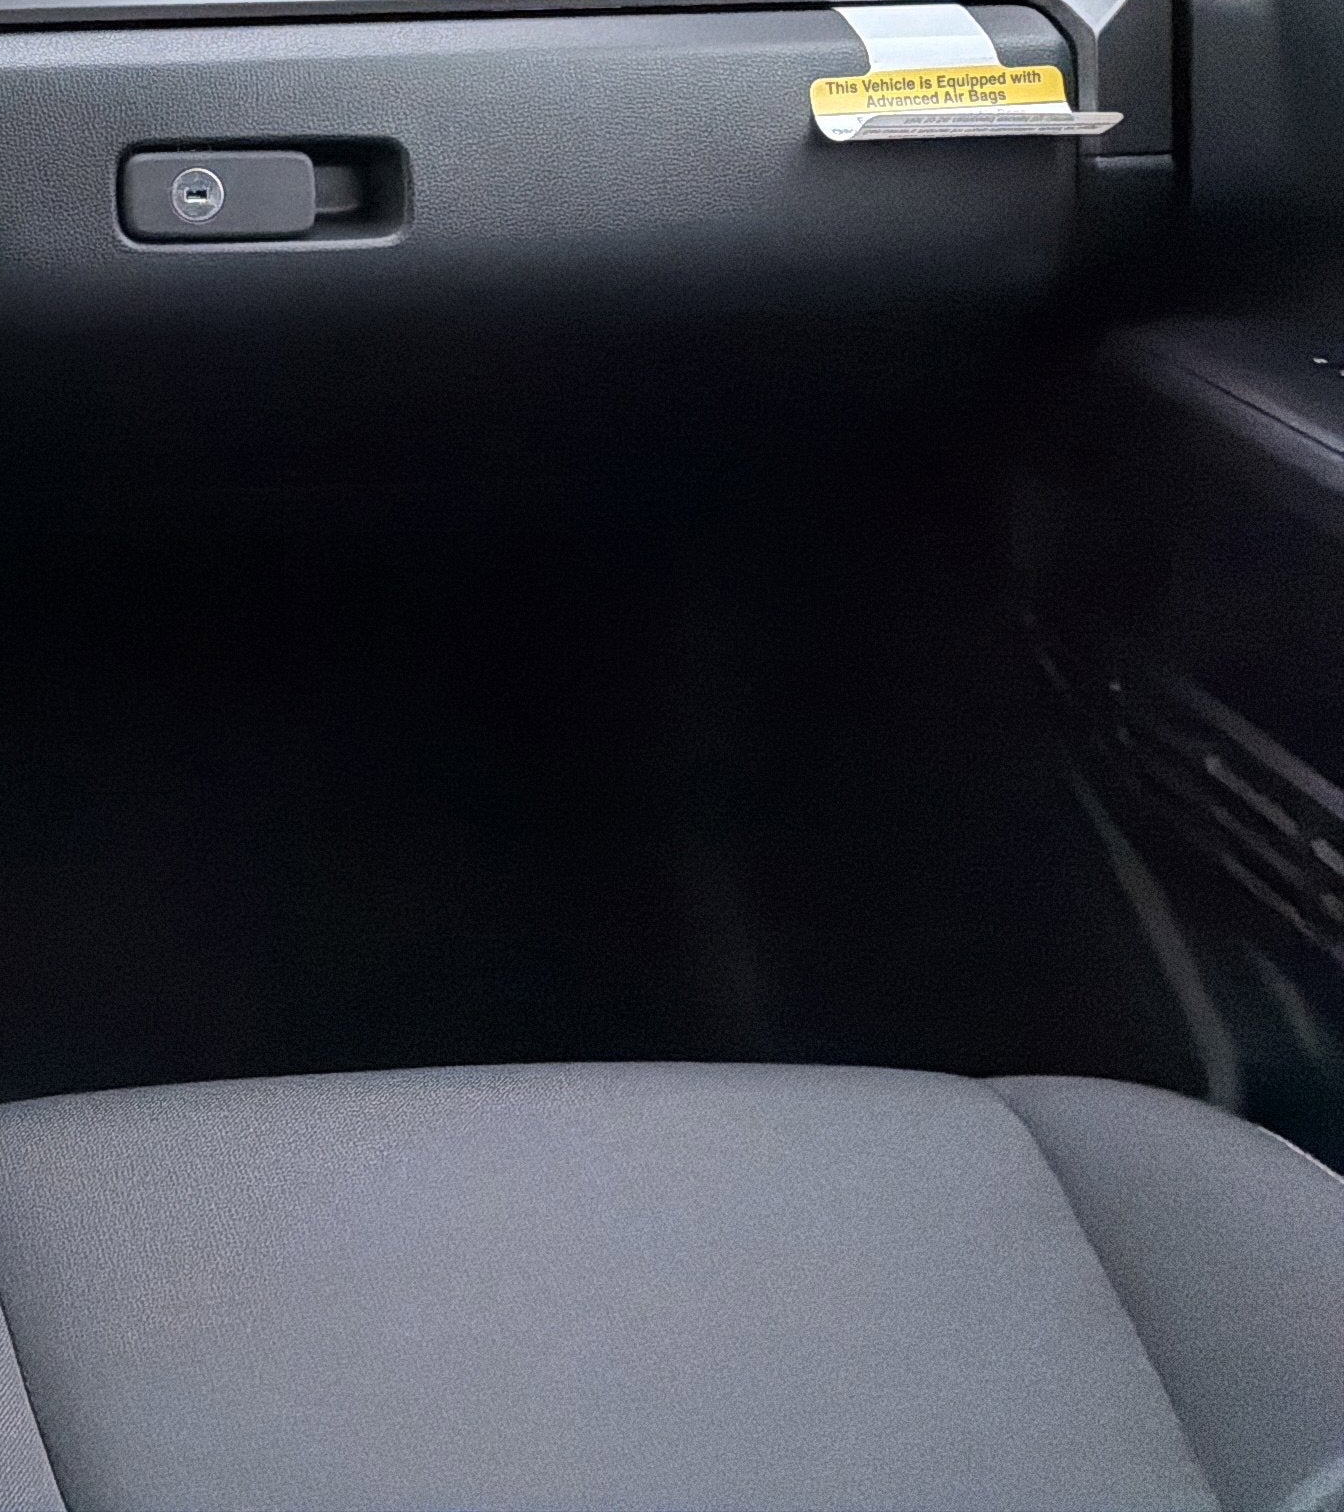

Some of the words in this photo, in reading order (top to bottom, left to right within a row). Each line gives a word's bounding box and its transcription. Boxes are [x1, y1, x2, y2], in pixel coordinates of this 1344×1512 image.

[825, 80, 858, 96] This
[861, 76, 916, 94] Vehicle
[919, 75, 933, 90] is
[936, 71, 1007, 94] Equipped
[1010, 69, 1042, 85] with
[866, 90, 940, 109] Advanced
[943, 88, 965, 105] Air
[968, 87, 1007, 105] Bags
